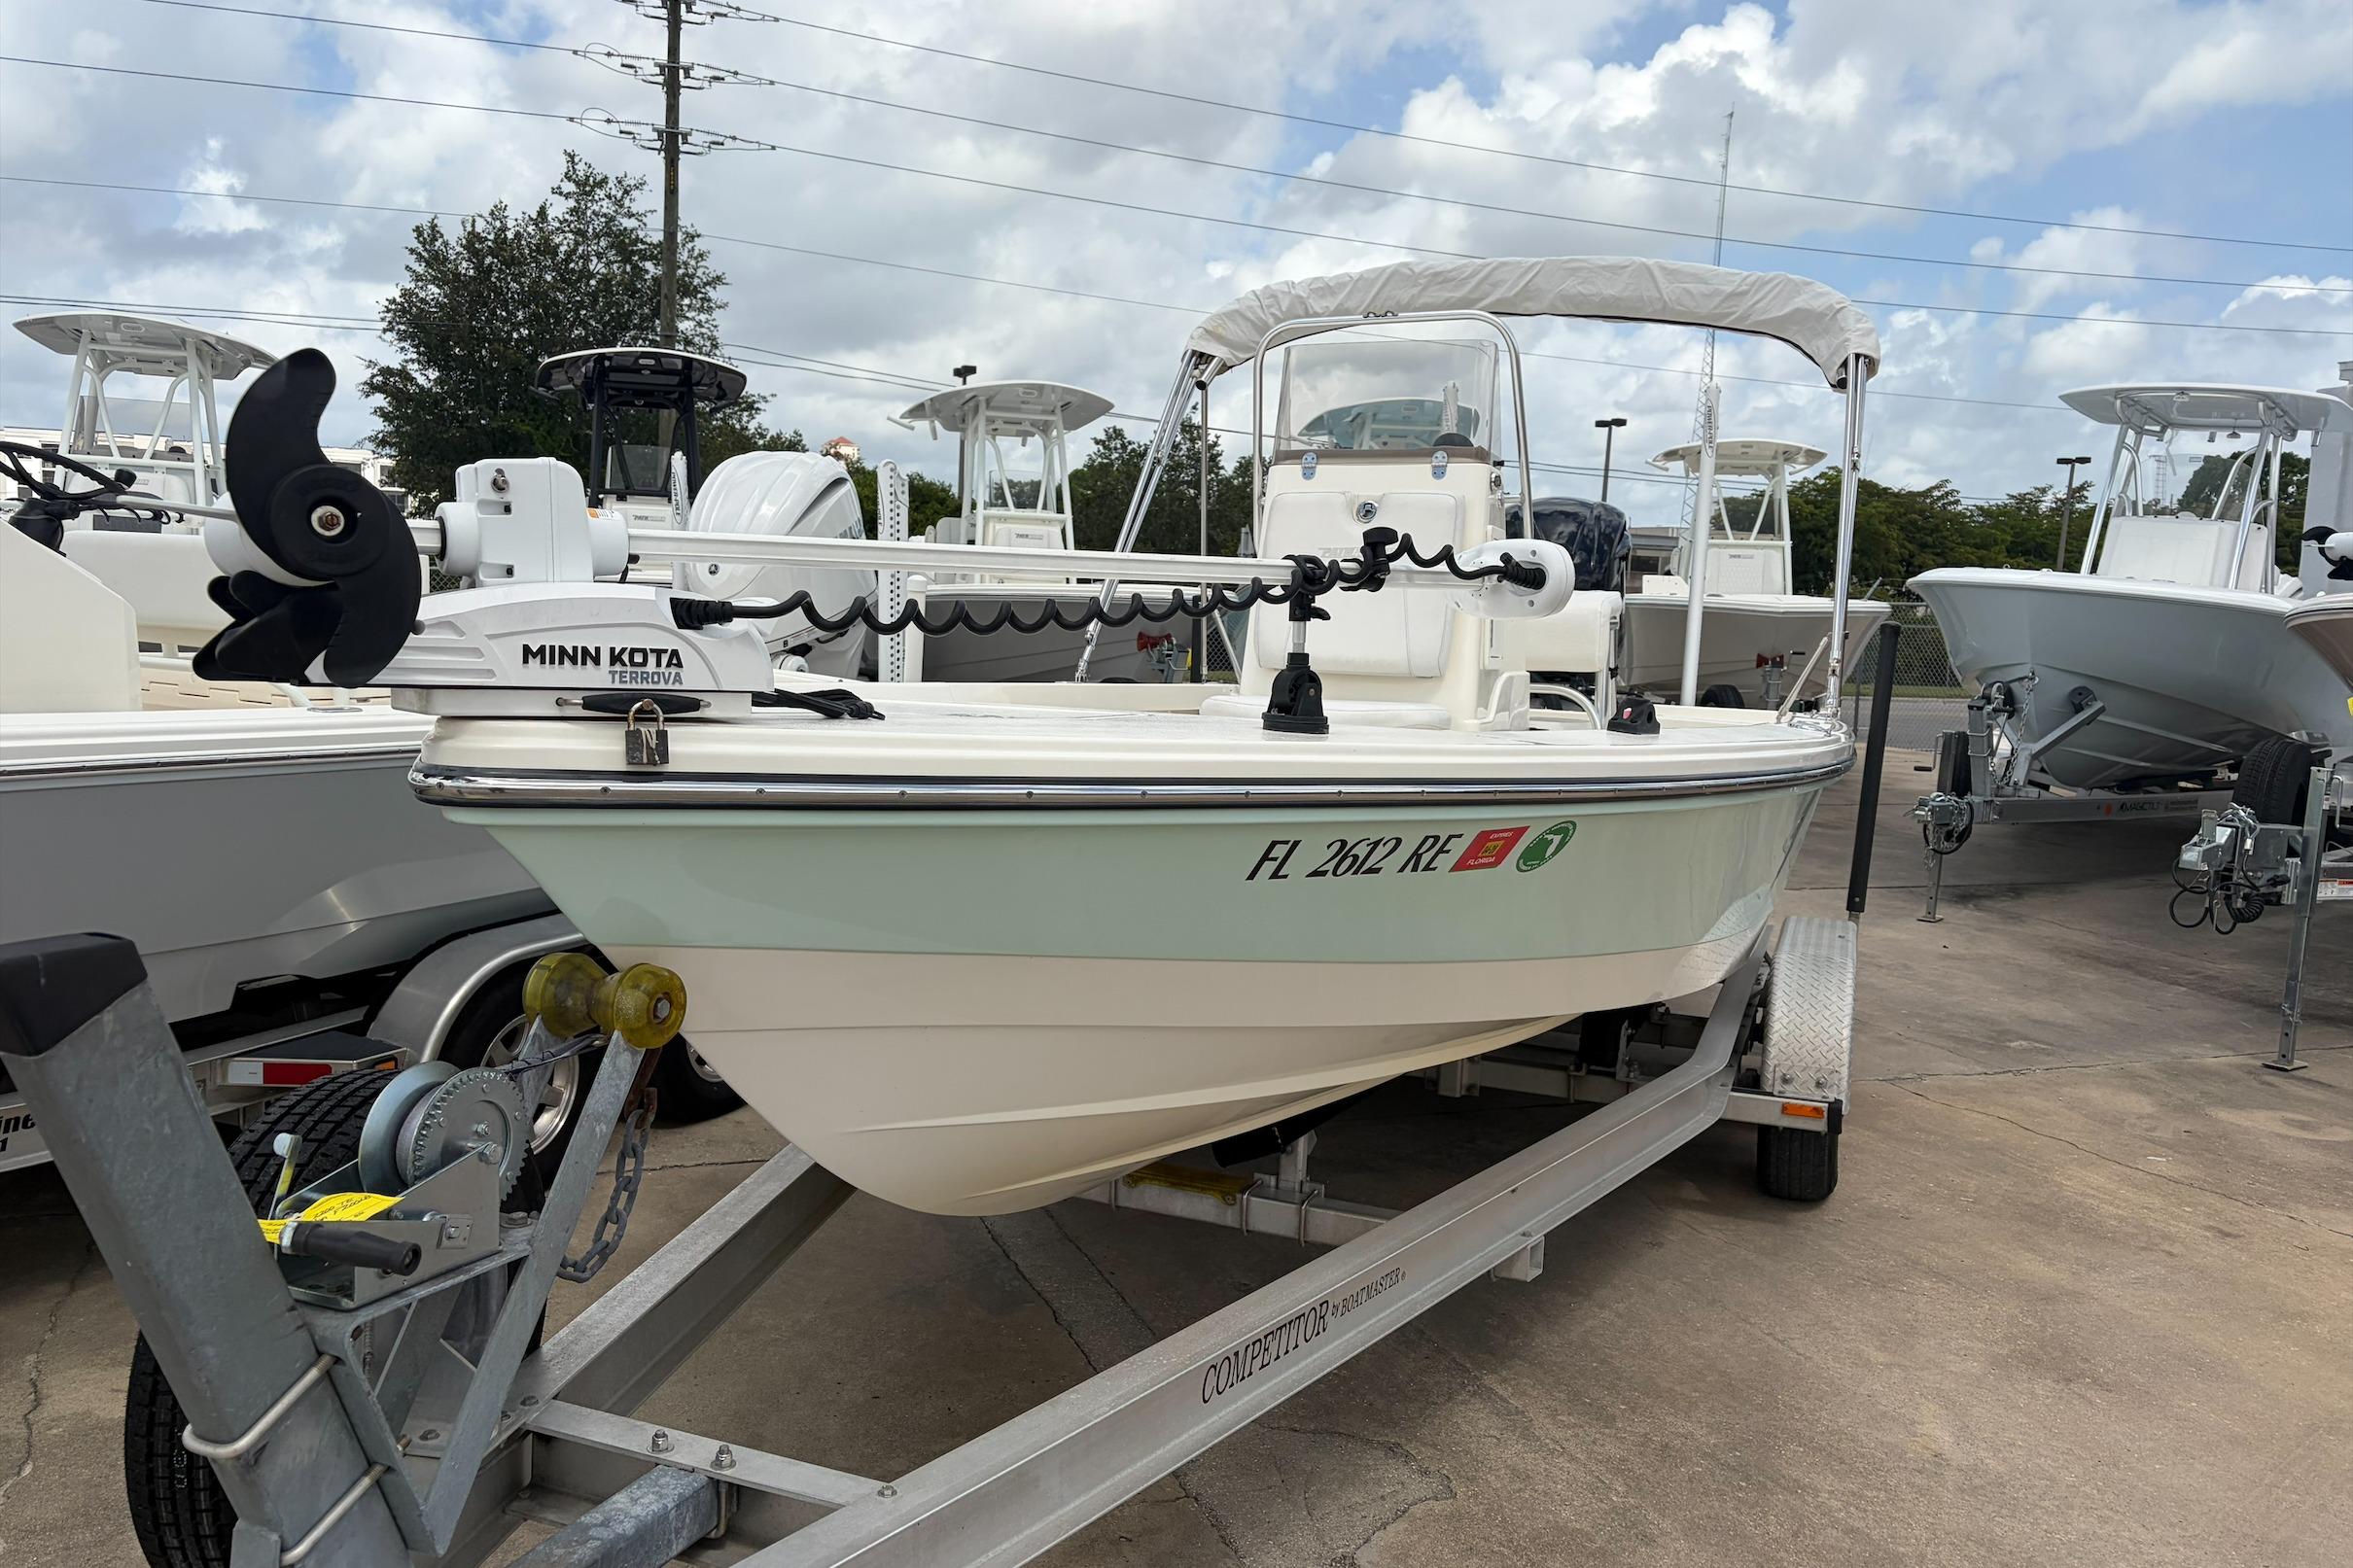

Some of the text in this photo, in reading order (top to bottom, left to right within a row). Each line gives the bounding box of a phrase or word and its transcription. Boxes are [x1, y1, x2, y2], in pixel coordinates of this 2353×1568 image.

[522, 644, 684, 669] MINN KOTA
[609, 670, 683, 685] TERROVA
[1246, 833, 1464, 881] FL 2612 RE
[1466, 856, 1495, 865] FLORIDA
[1202, 1300, 1329, 1404] COMPETITOR
[1331, 1302, 1341, 1319] by
